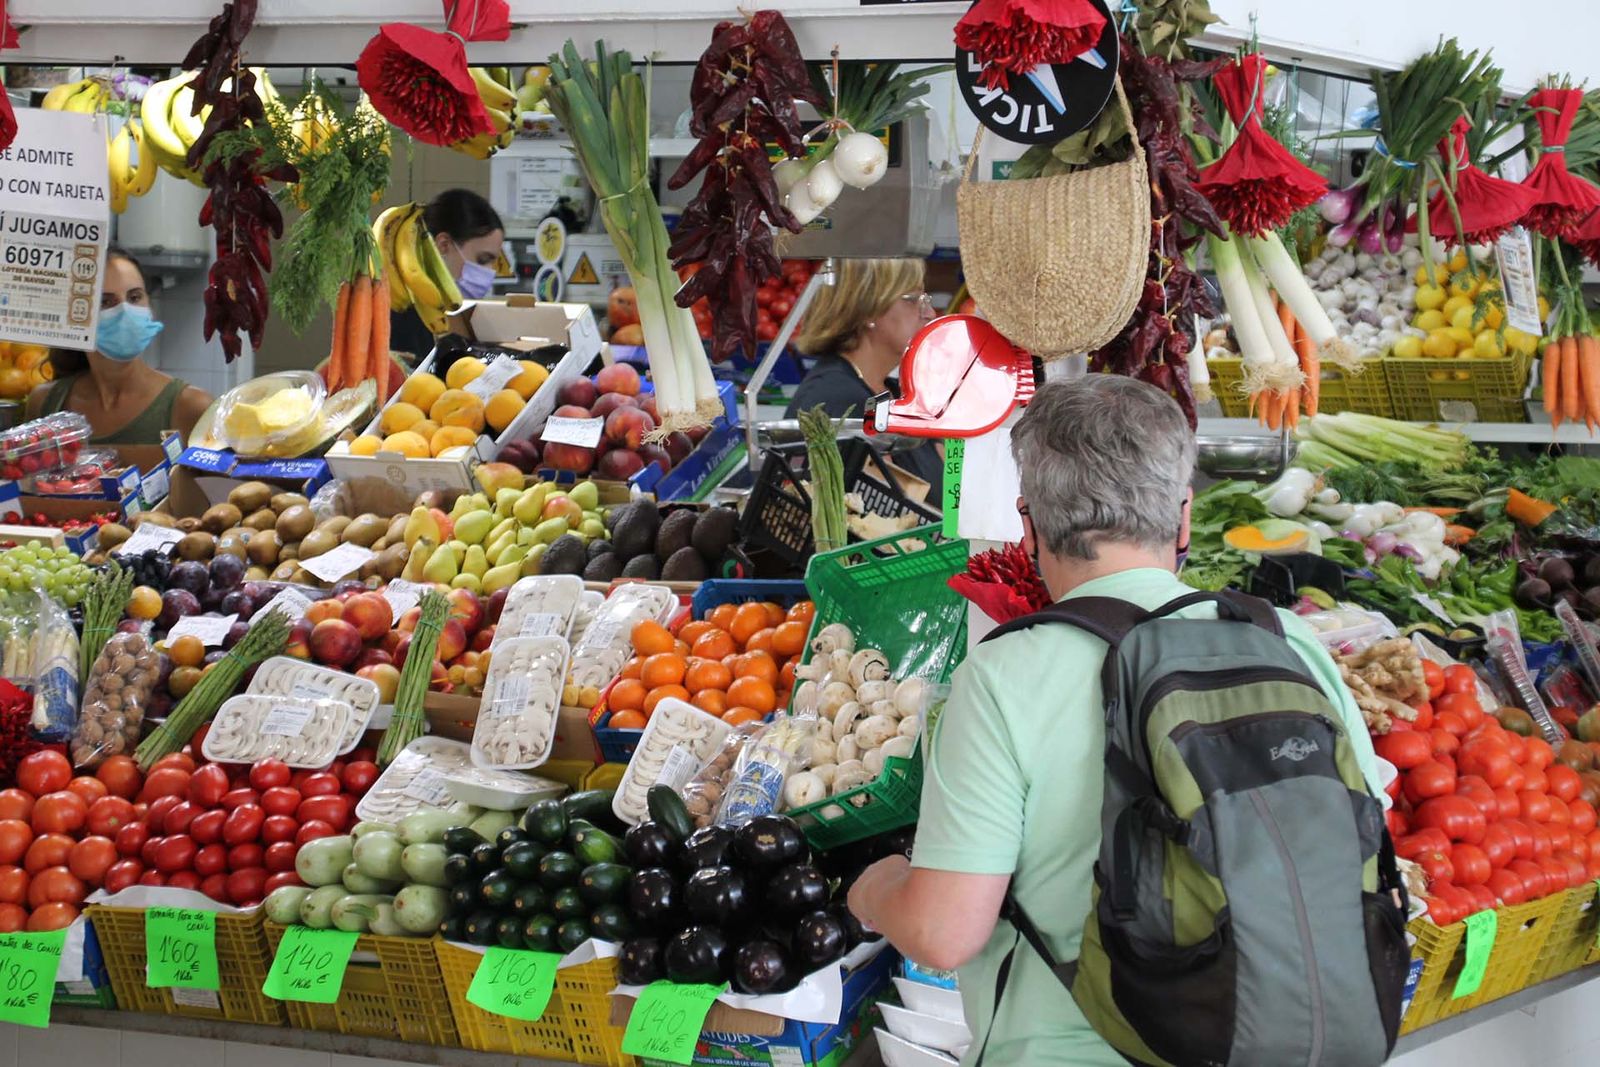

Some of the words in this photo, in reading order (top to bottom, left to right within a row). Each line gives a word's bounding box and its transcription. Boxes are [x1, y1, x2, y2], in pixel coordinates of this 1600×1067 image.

[16, 148, 74, 167] ADMITE
[8, 178, 41, 195] CON
[45, 182, 105, 201] TARJETA
[9, 217, 100, 241] JUGAMOS
[5, 246, 64, 269] 60971
[946, 462, 960, 475] SE
